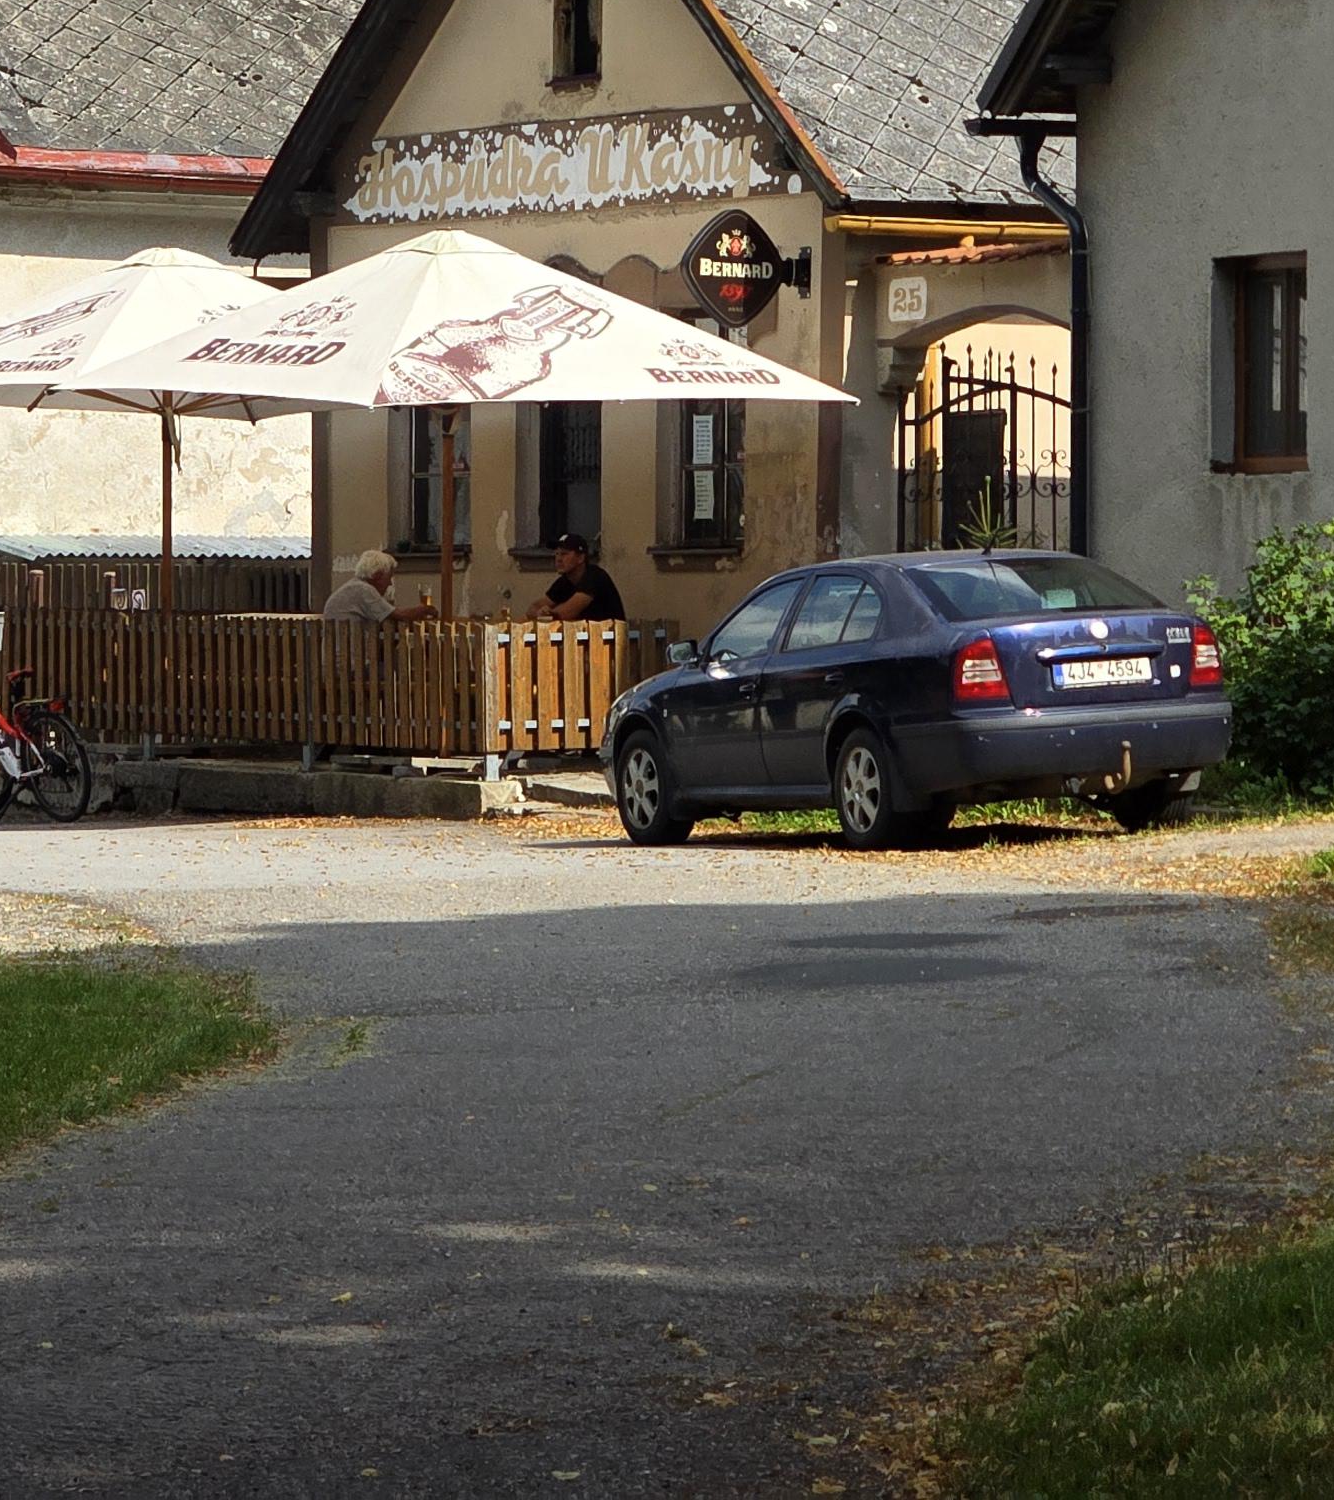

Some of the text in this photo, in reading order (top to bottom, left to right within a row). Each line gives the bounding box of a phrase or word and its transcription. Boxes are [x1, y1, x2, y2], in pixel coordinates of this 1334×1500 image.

[577, 126, 616, 195] U
[618, 122, 757, 198] Kašny
[699, 257, 774, 280] BERNARD
[893, 284, 923, 313] 25
[178, 338, 347, 366] BERNARD
[643, 367, 781, 385] BERNARD
